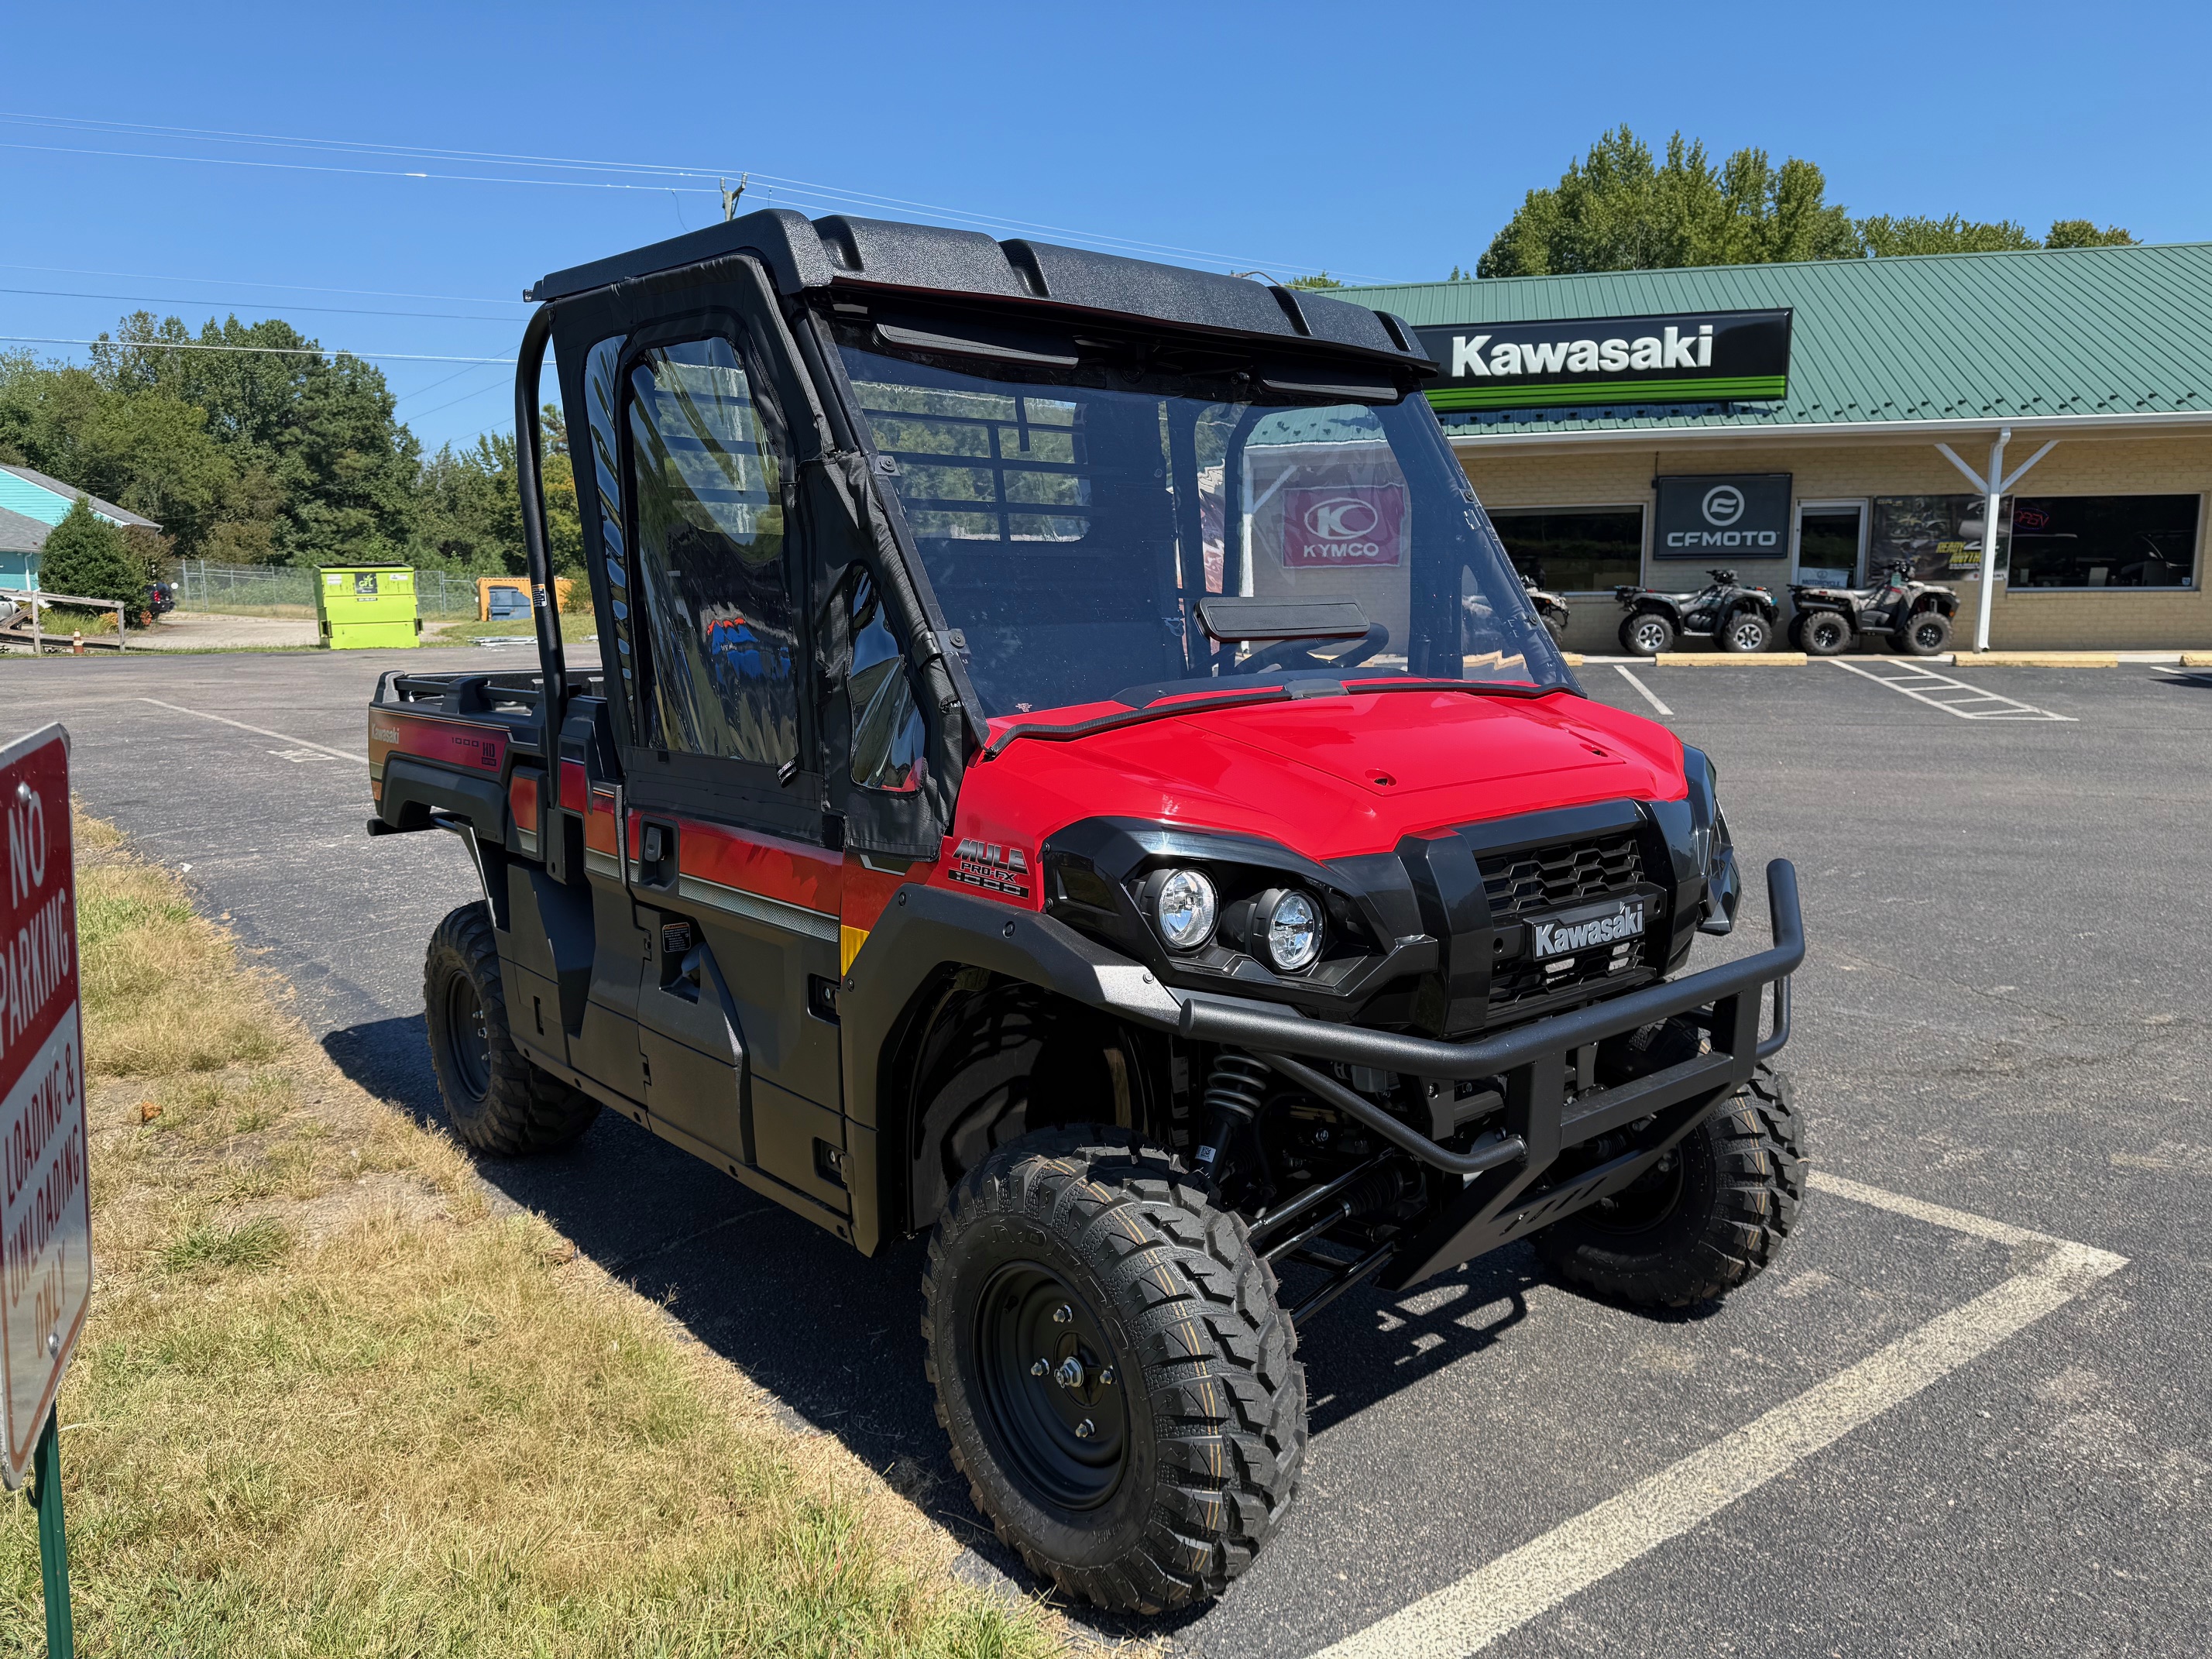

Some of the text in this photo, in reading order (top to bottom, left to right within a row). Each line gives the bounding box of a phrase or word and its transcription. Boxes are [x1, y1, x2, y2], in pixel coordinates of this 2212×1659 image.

[1451, 325, 1713, 377] Kawasaki
[2014, 510, 2049, 527] OPEN
[1304, 542, 1379, 558] KYMCO
[1667, 531, 1777, 547] CFMOTO
[1936, 541, 1966, 553] READY
[371, 723, 400, 744] Kawasaki
[452, 737, 496, 758] 1000 HD
[8, 790, 46, 909] NO
[952, 837, 1031, 875] MULE
[955, 871, 1022, 895] 1000
[960, 860, 1017, 883] PRO-FX
[1535, 903, 1644, 957] Kawasaki
[0, 888, 70, 1060] PARKING
[5, 1042, 75, 1208] LOADING &
[9, 1123, 81, 1309] UNLOADING
[35, 1239, 66, 1360] ONLY
